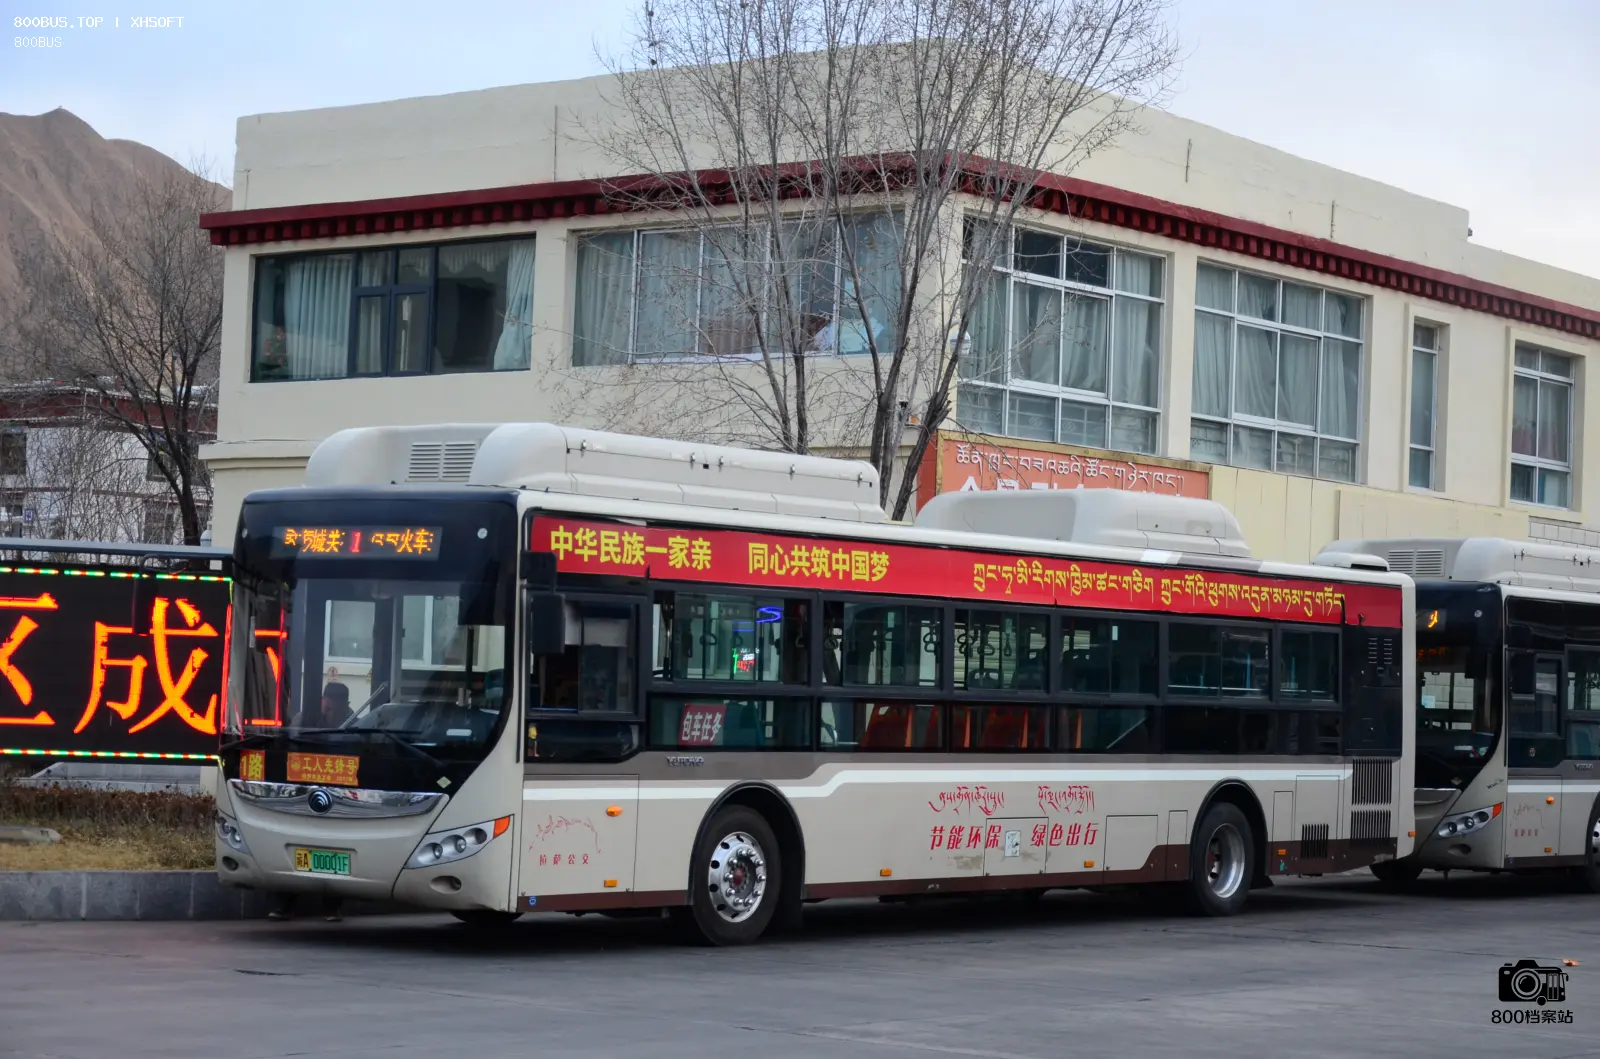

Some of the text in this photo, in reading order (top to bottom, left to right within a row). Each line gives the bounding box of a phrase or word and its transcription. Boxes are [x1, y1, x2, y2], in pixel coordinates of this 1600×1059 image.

[550, 525, 890, 582] 中华民族一家亲 同心共筑中国梦
[681, 711, 723, 742] 包车任务
[240, 753, 264, 779] 1路
[930, 824, 1002, 851] 节能环保
[1030, 822, 1099, 847] 绿色出行
